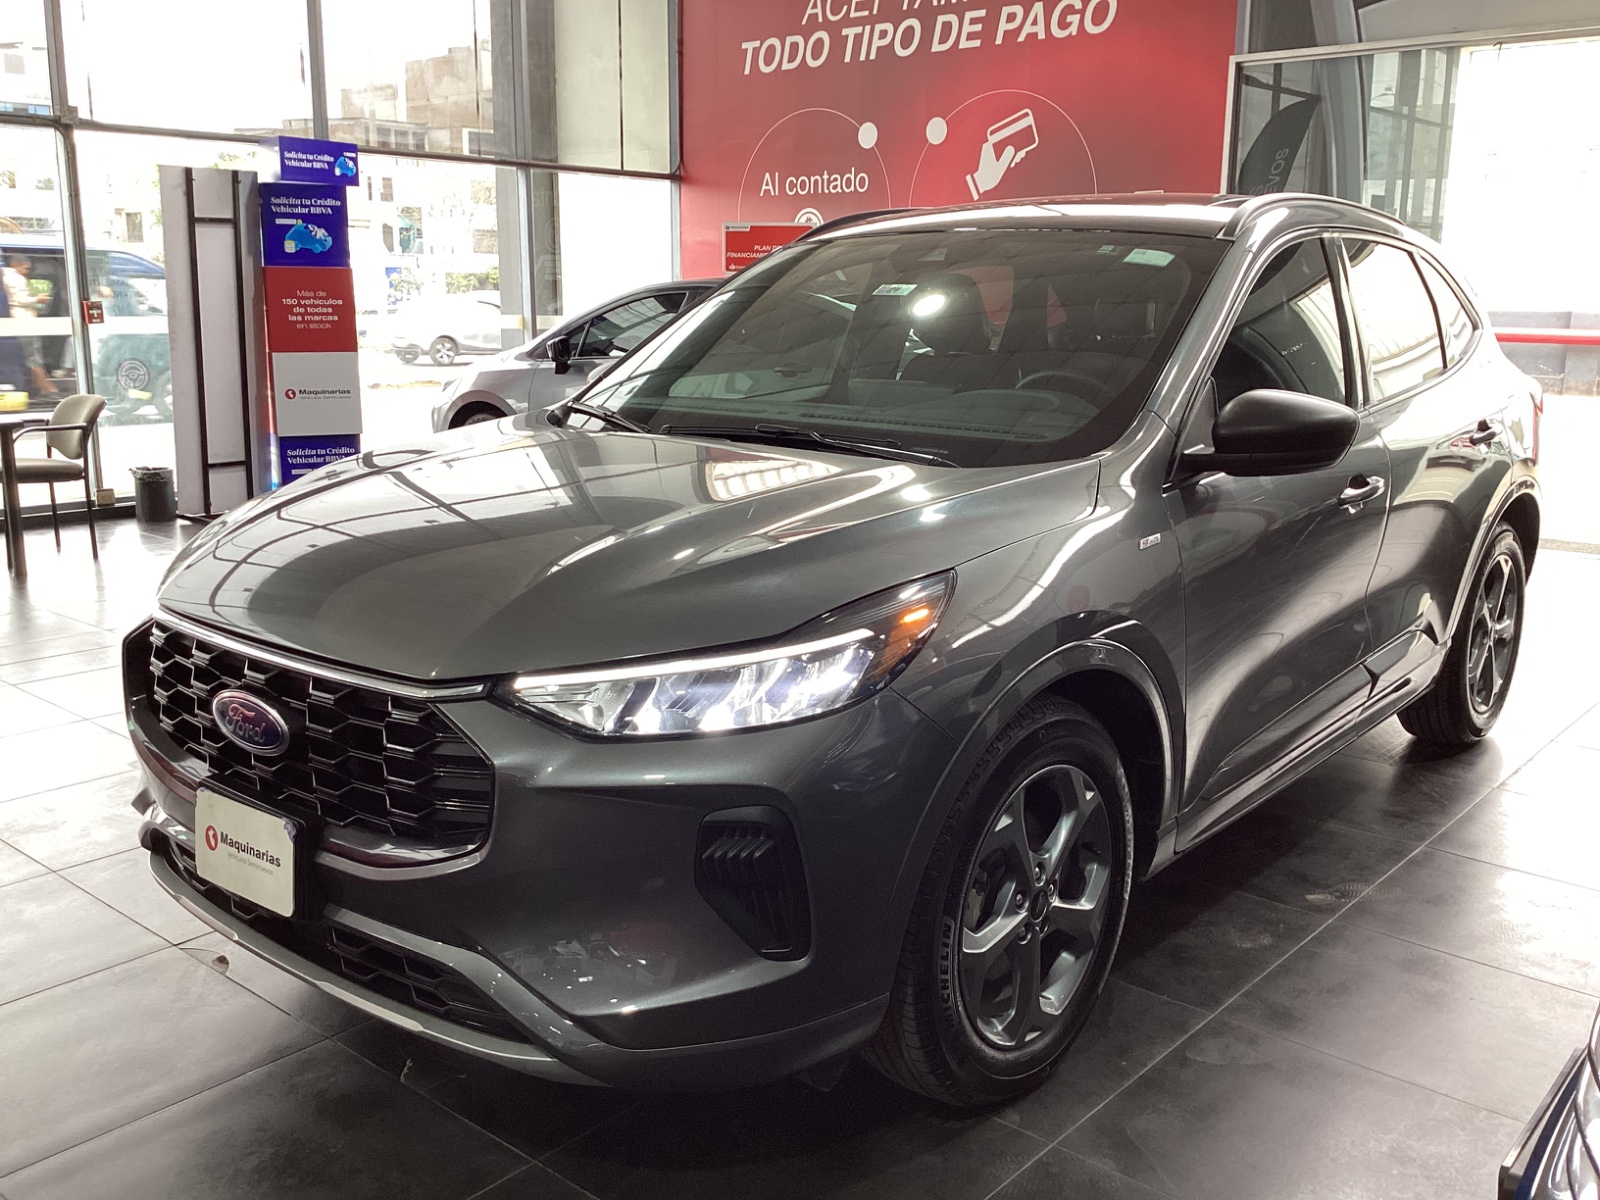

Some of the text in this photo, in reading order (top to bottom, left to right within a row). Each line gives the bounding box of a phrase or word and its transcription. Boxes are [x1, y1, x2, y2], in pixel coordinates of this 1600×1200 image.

[741, 0, 1118, 75] TODO TIPO DE PAGO
[284, 151, 307, 159] Solicita
[284, 159, 313, 168] Vehicular
[760, 167, 869, 196] Al contado
[270, 197, 301, 205] Solicita
[271, 206, 309, 214] Vehicular
[287, 448, 316, 456] Solicita
[326, 446, 355, 454] Crédito
[287, 456, 324, 464] Vehicular
[225, 703, 267, 744] Ford
[220, 831, 281, 868] Maquinarias
[940, 922, 955, 1027] MICHELIN
